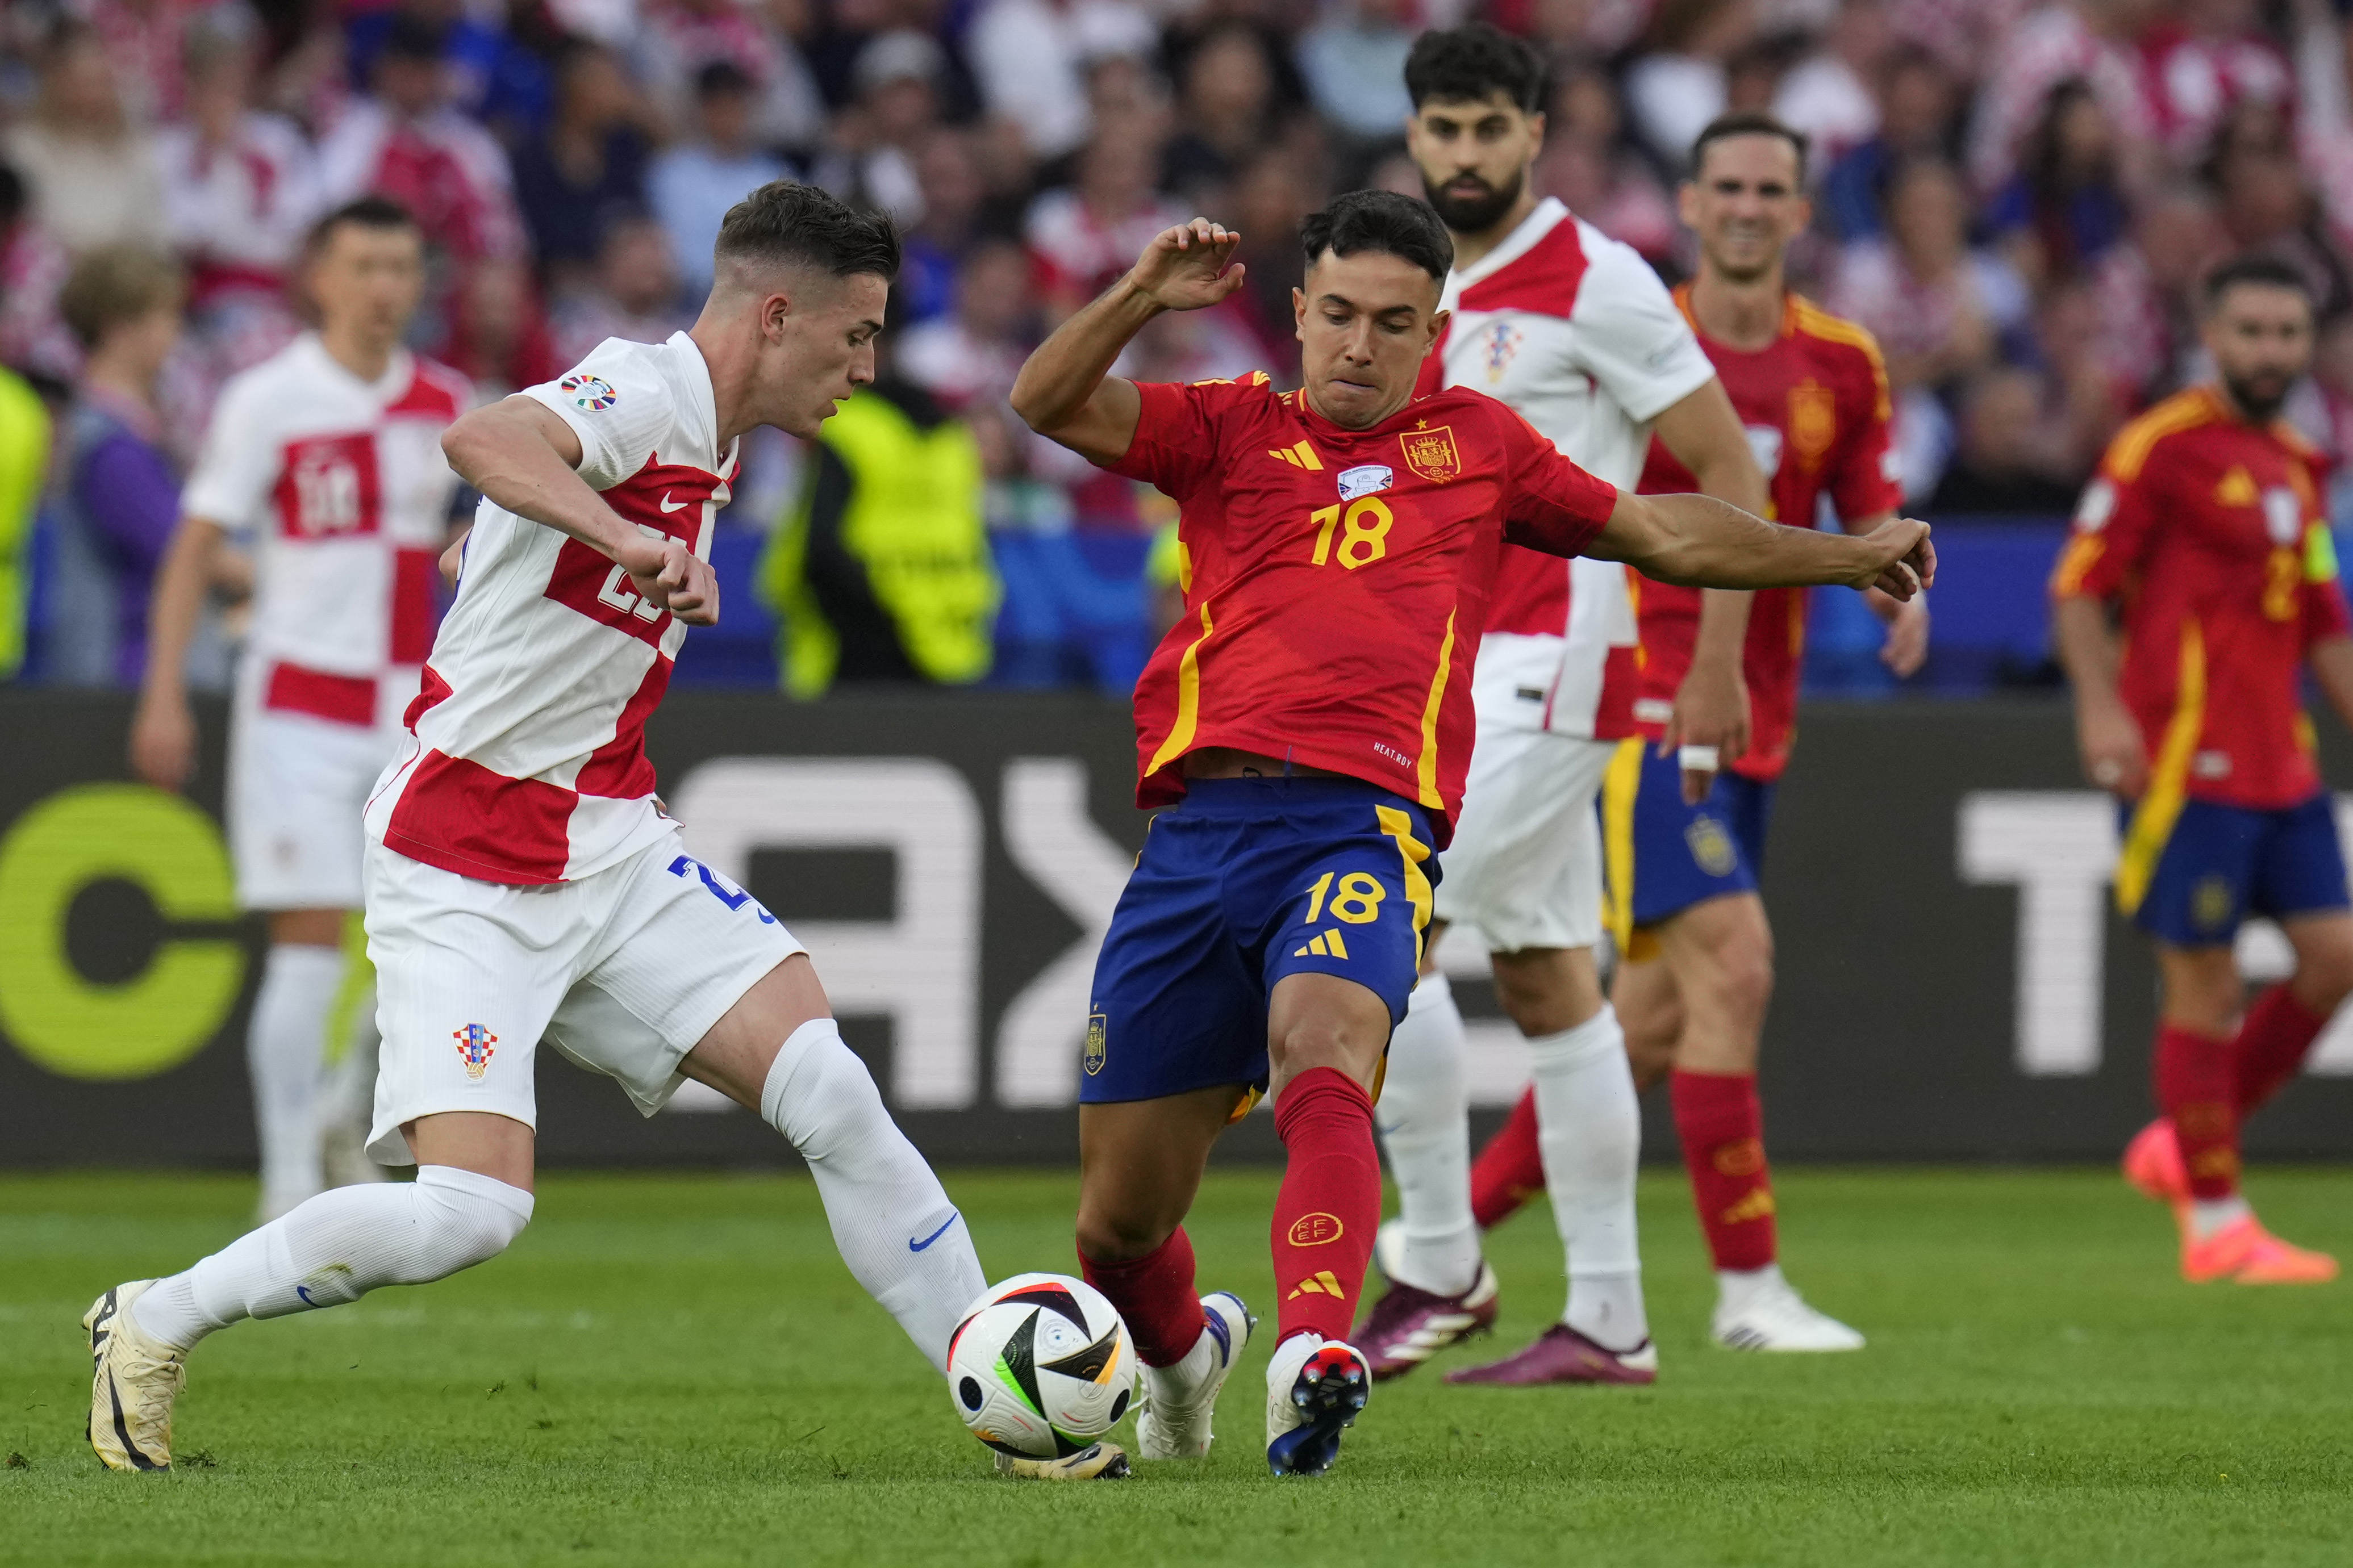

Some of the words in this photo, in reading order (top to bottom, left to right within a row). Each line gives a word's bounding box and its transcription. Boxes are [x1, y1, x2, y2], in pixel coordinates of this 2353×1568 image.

[1311, 496, 1393, 570] 18
[1374, 742, 1412, 768] HEAT.RDY
[1305, 872, 1387, 924] 18
